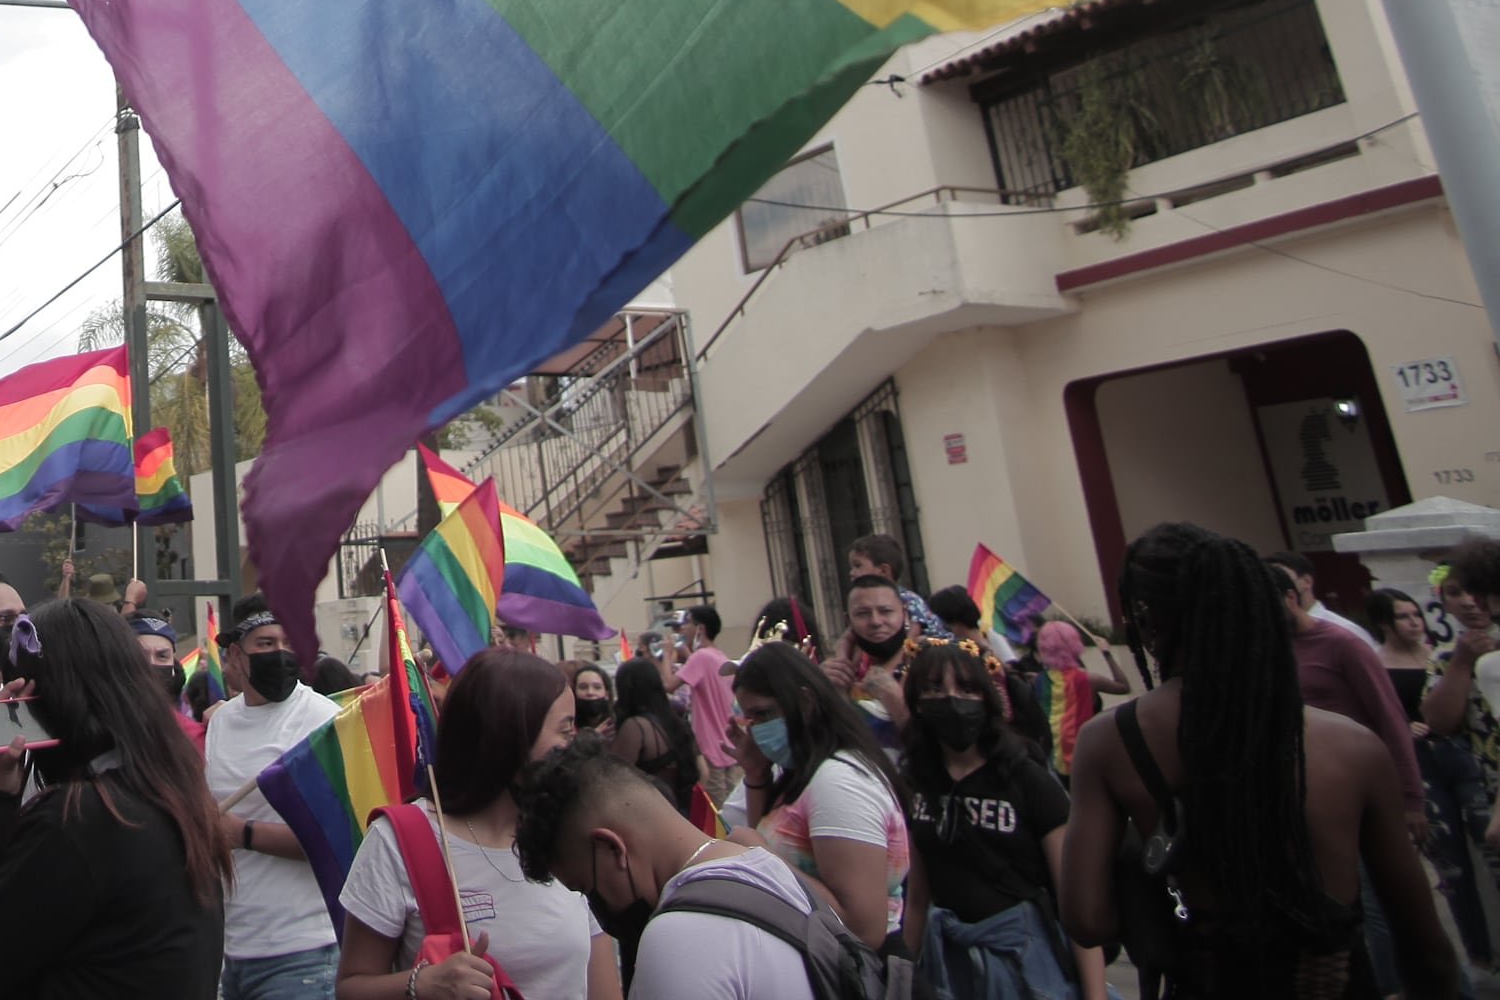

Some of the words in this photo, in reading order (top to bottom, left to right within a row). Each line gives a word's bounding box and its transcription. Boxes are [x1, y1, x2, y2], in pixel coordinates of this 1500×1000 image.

[1397, 361, 1453, 388] 1733
[1432, 467, 1474, 485] 1733
[1294, 496, 1380, 524] möller
